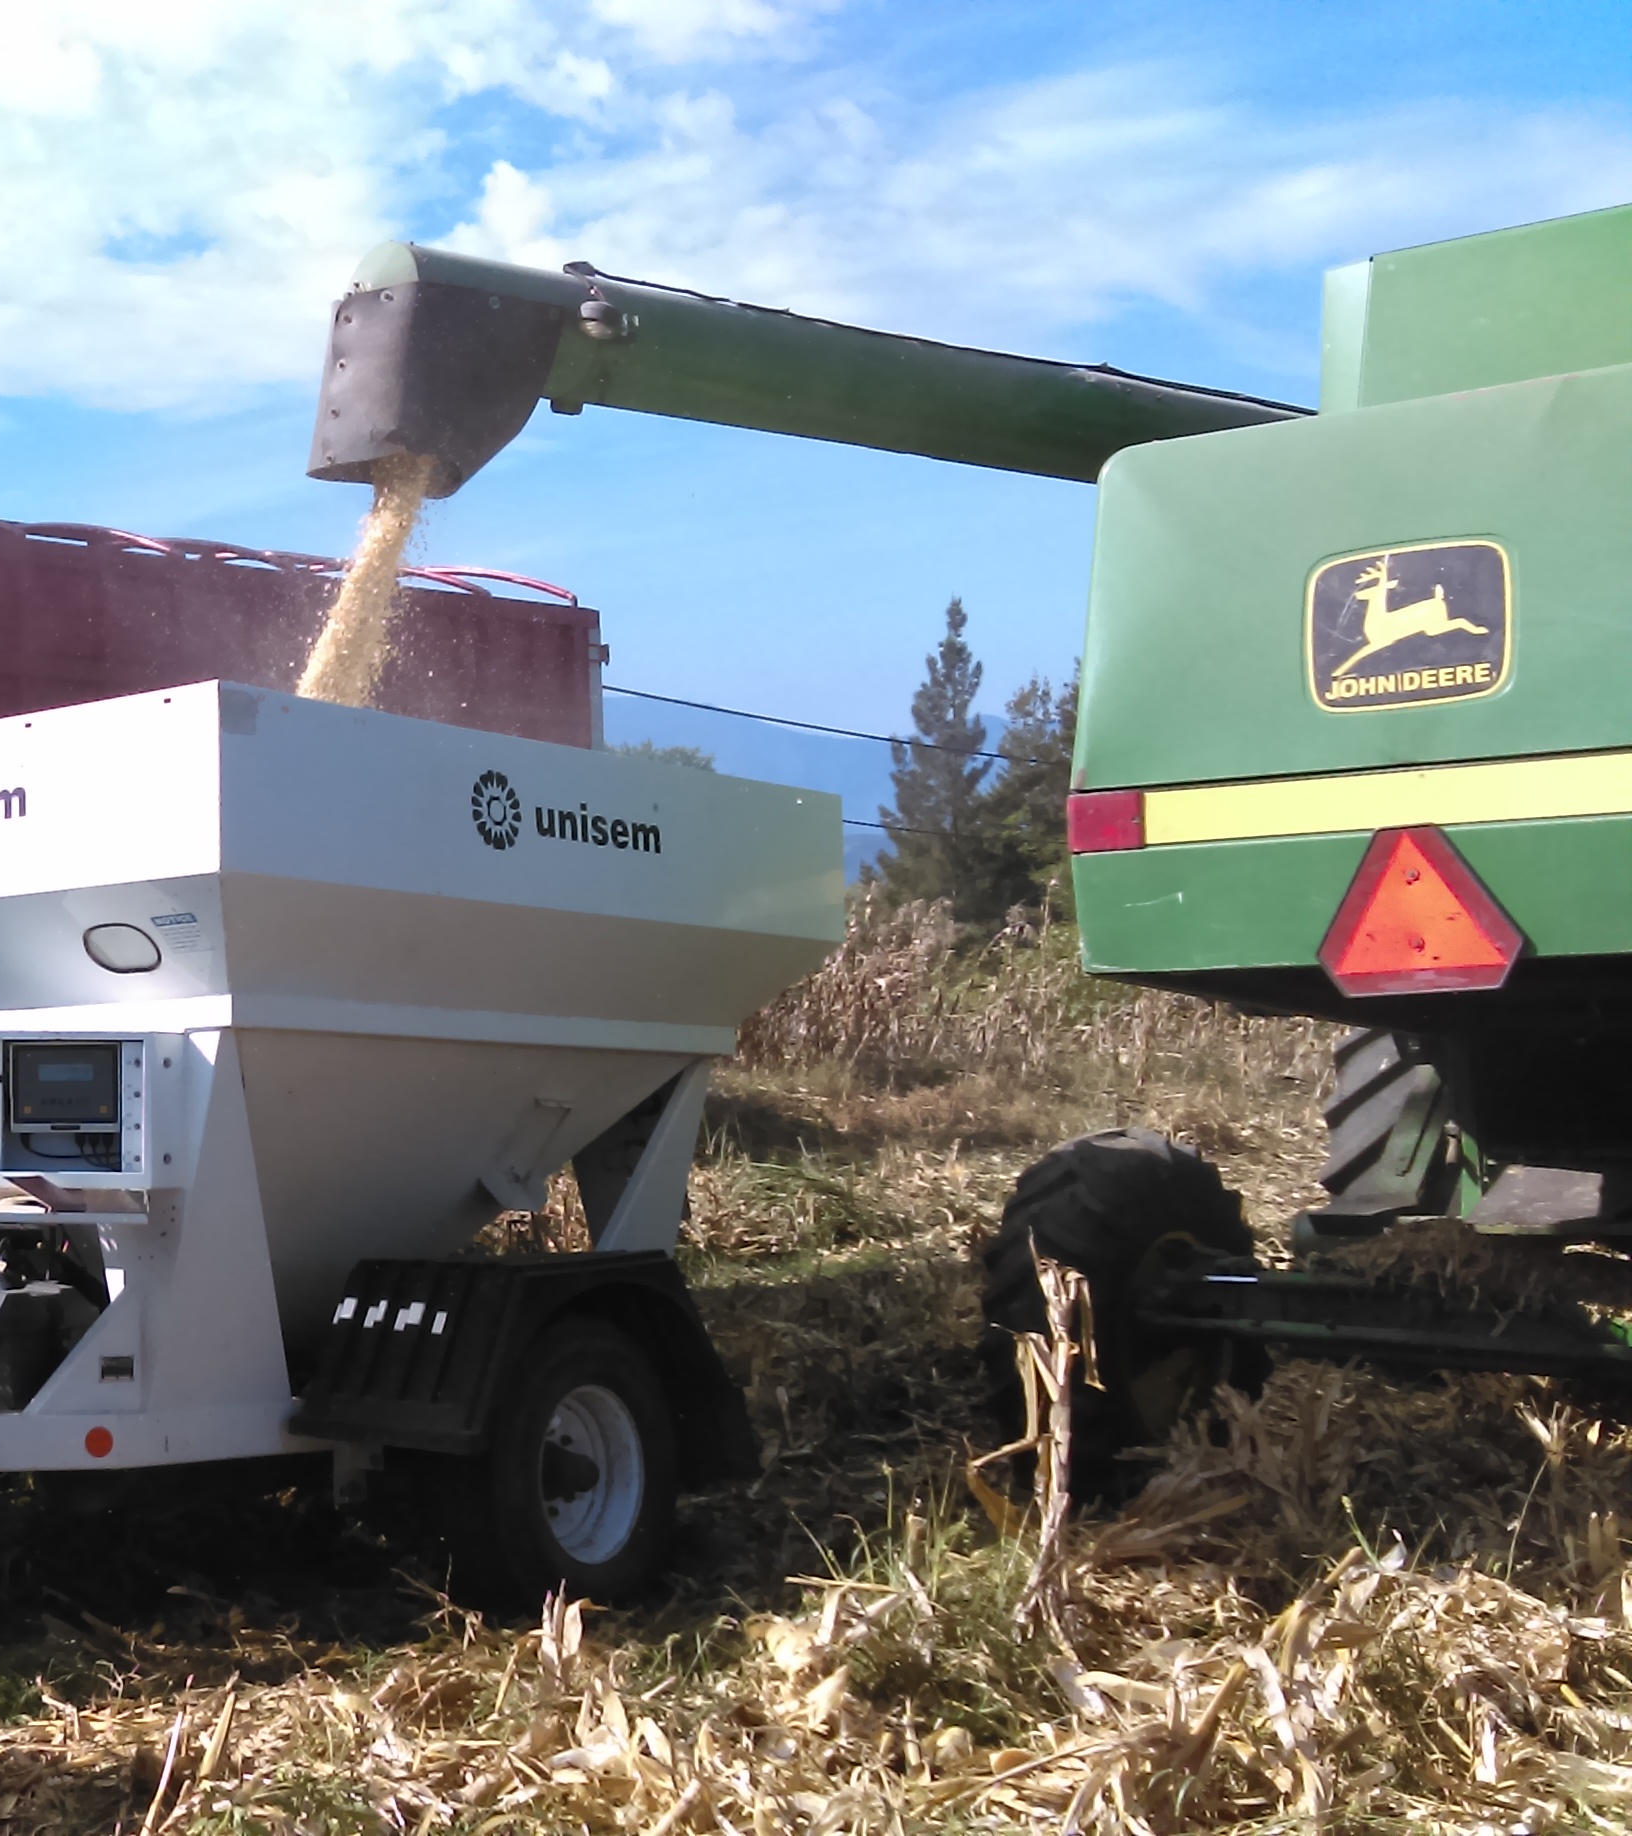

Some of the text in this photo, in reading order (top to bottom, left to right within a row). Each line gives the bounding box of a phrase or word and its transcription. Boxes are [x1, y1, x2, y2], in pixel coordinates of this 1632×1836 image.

[1325, 663, 1491, 700] JOHN DEERE
[535, 802, 662, 854] unisem
